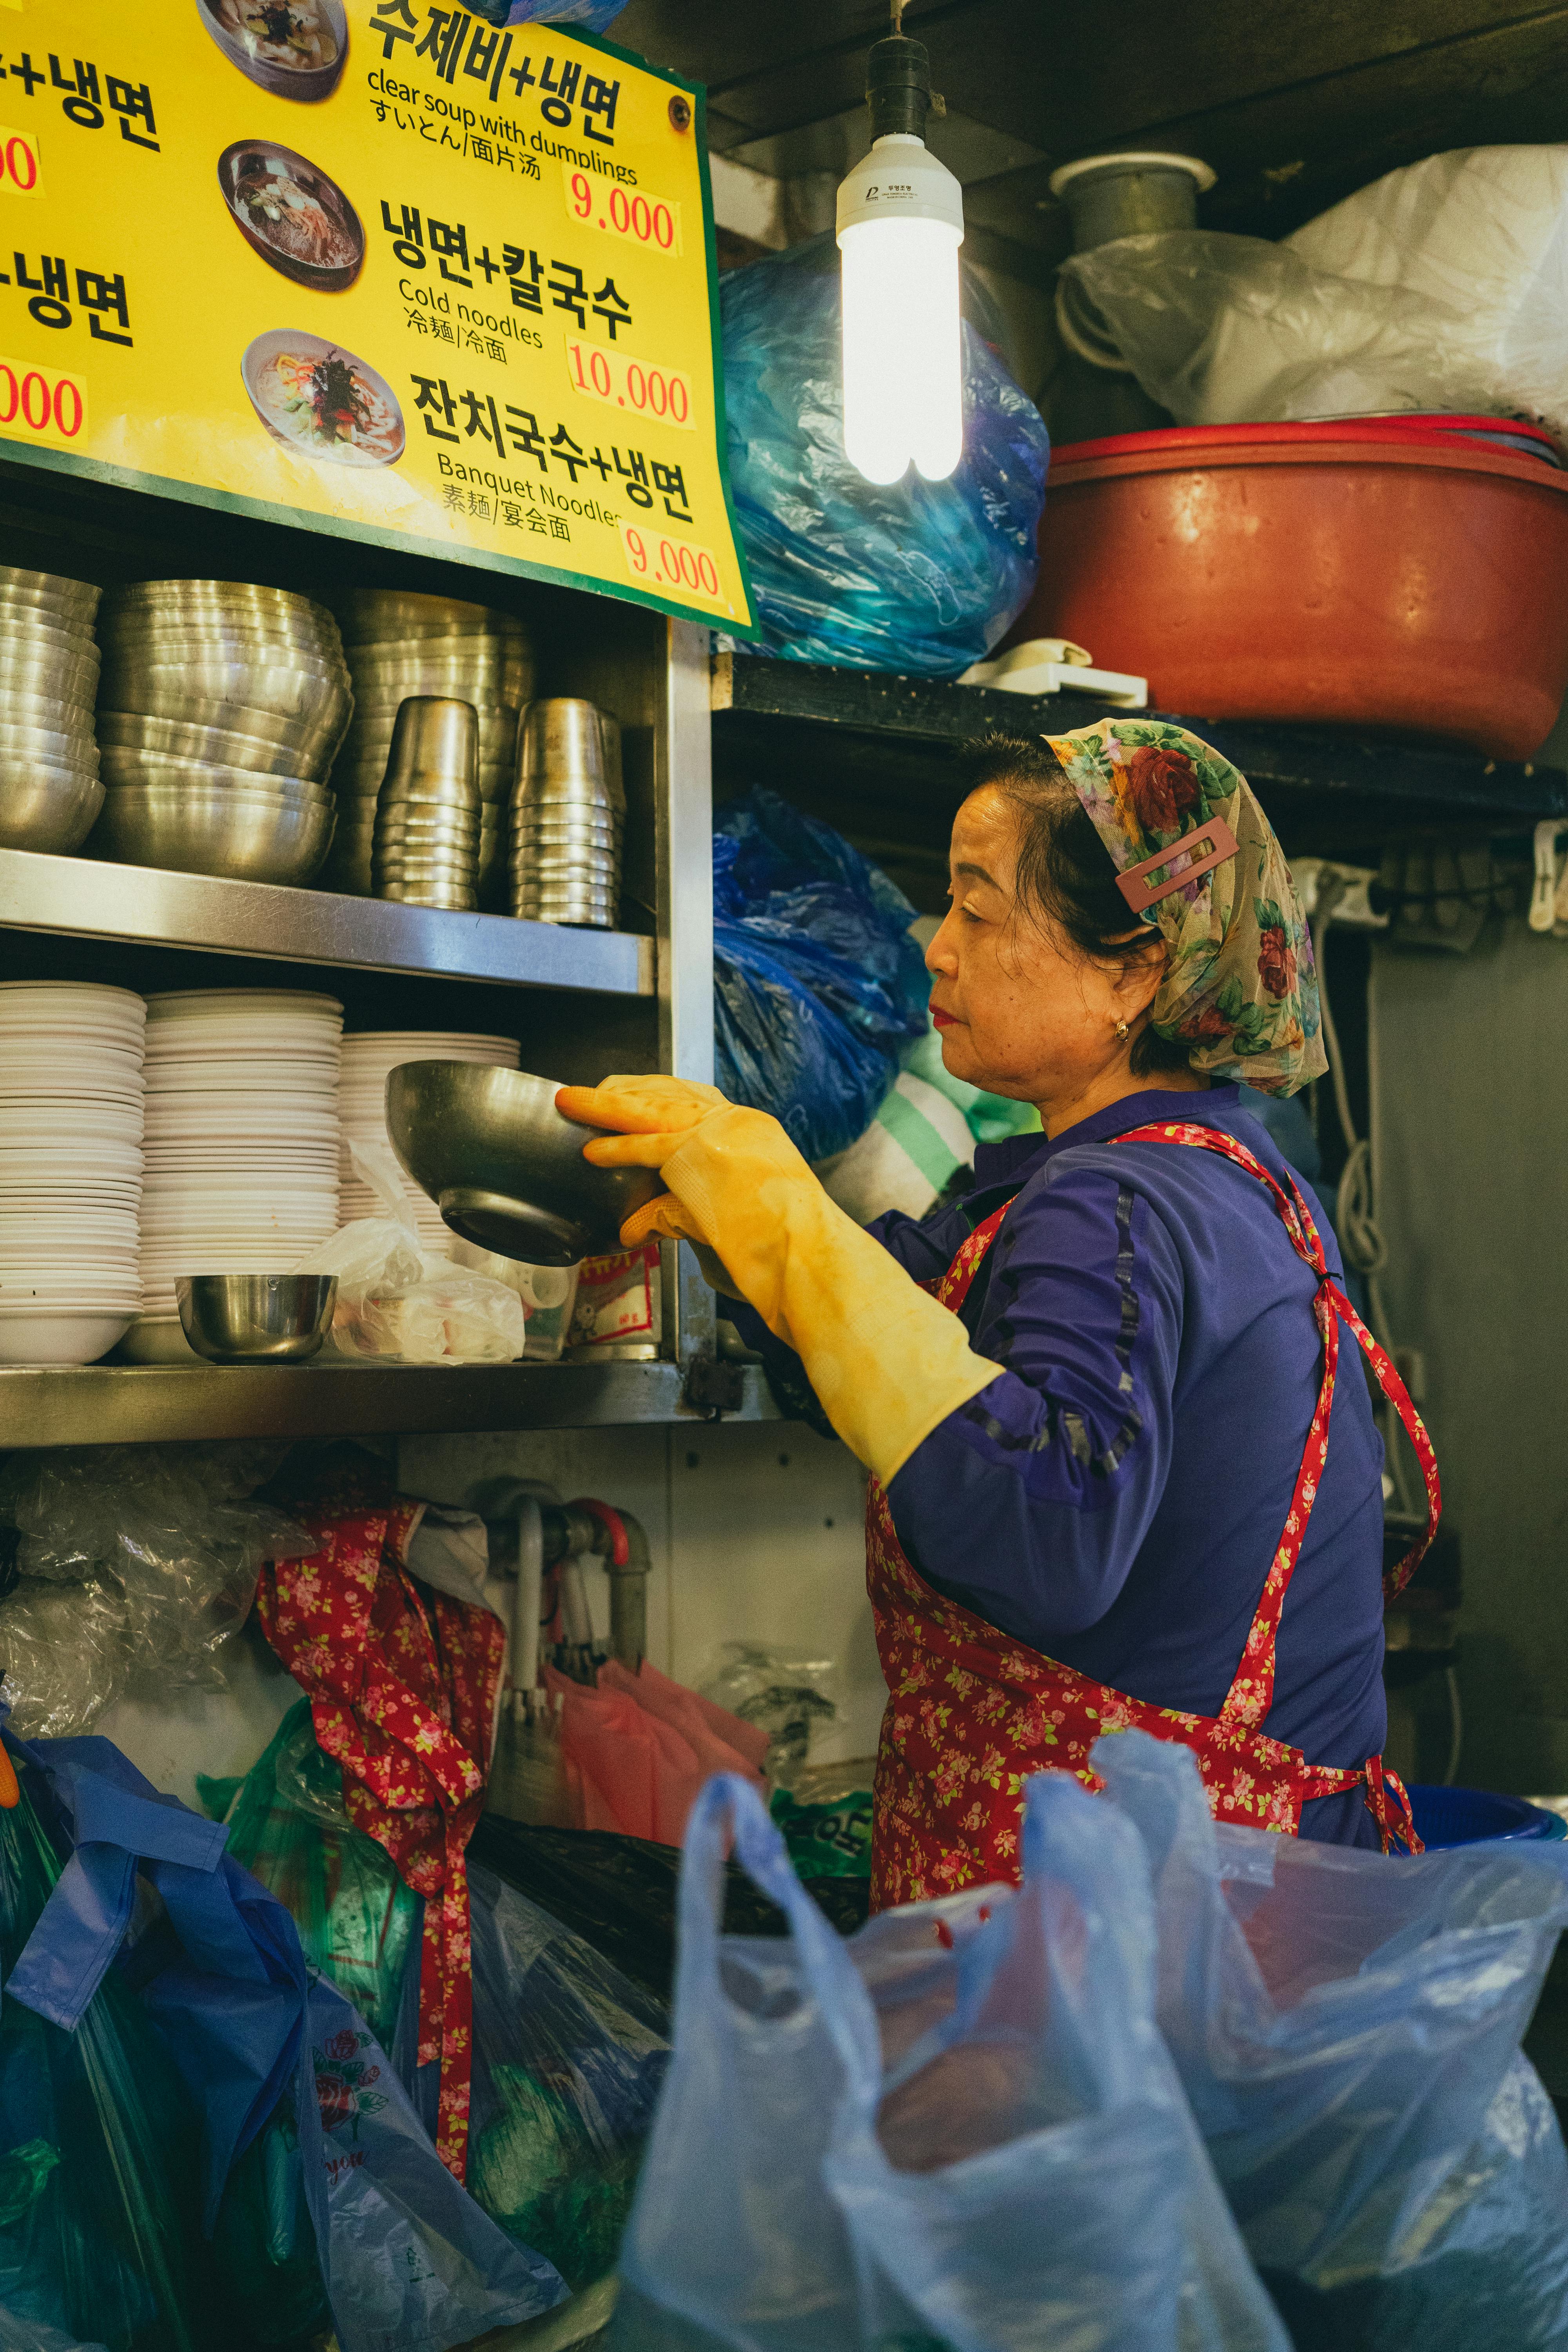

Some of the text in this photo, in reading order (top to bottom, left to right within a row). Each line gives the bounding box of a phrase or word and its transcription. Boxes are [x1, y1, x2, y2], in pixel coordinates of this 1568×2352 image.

[0, 52, 161, 153] +냉면
[368, 0, 621, 146] 수제비+냉면
[0, 137, 37, 190] 0
[368, 69, 638, 185] clear soup with dumplings
[370, 99, 541, 180] すいとん/面片汤
[571, 173, 673, 248] 9.000
[380, 200, 632, 340] 냉면+칼국수
[399, 279, 543, 348] Cold noodles
[570, 345, 688, 422] 10.000
[410, 374, 693, 524] 잔치국수+냉면
[438, 453, 535, 501] Banquet
[627, 529, 718, 595] 9.000
